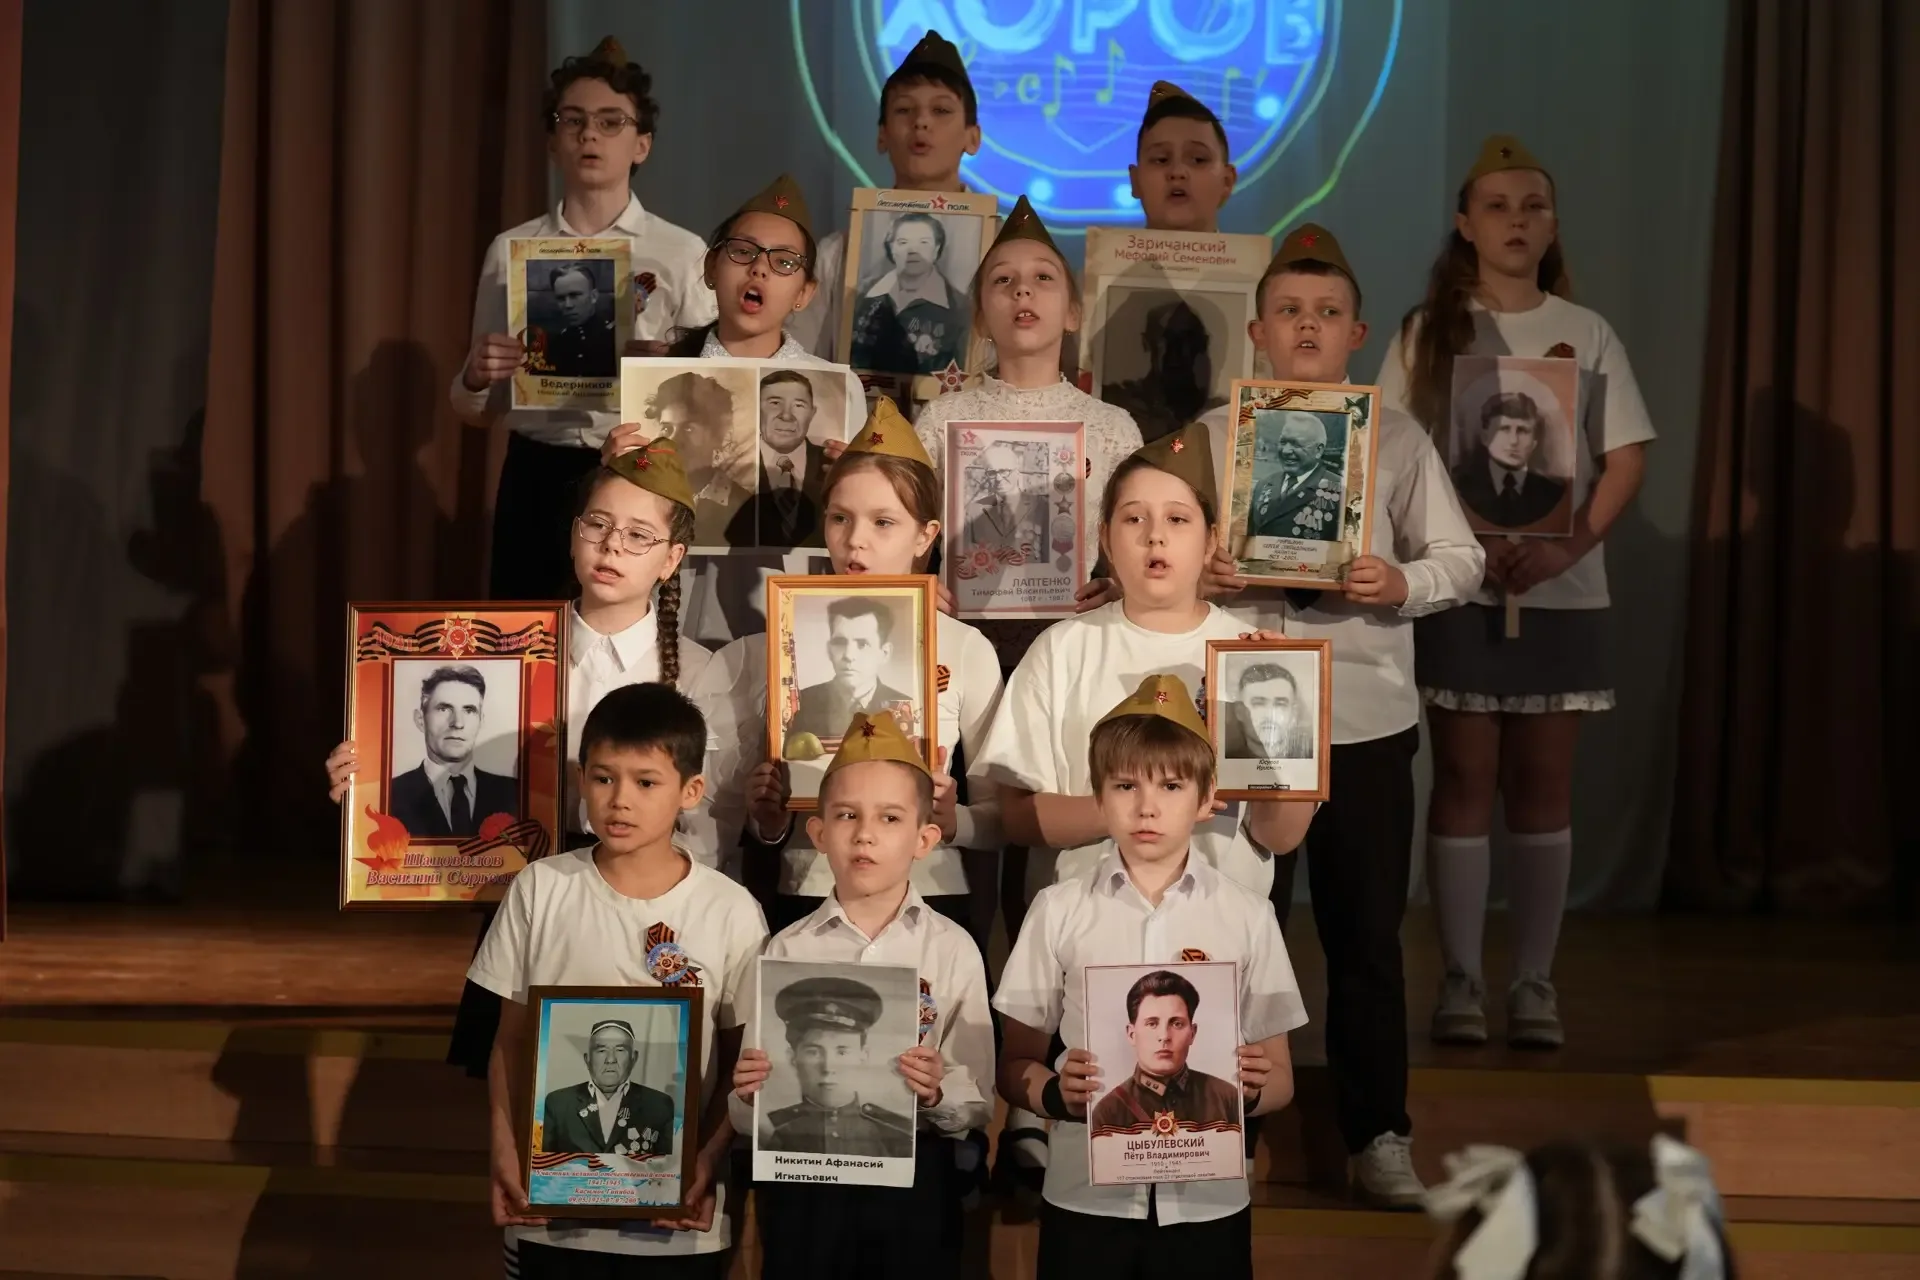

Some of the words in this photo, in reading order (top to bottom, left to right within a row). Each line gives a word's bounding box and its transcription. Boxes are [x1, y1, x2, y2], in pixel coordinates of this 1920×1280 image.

[1127, 234, 1227, 254] Заричанский
[1115, 248, 1169, 262] Мефодий
[1172, 251, 1237, 265] Семенович
[540, 378, 613, 390] Ведерников
[1012, 577, 1072, 587] ЛАПТЕНКО
[971, 588, 1014, 597] Тимофей
[1016, 587, 1071, 595] Васильевич
[375, 630, 413, 651] 1941
[501, 630, 544, 651] 1945
[403, 852, 503, 868] Шаповалов
[366, 870, 441, 885] Василий
[1127, 1136, 1205, 1151] ЦЫБУЛЕВСКИЙ
[774, 1156, 822, 1166] Никитин
[825, 1158, 884, 1169] Афанасий
[1124, 1151, 1145, 1161] Пётр
[1146, 1150, 1210, 1160] Владимирович
[774, 1172, 839, 1182] Игнатьевич
